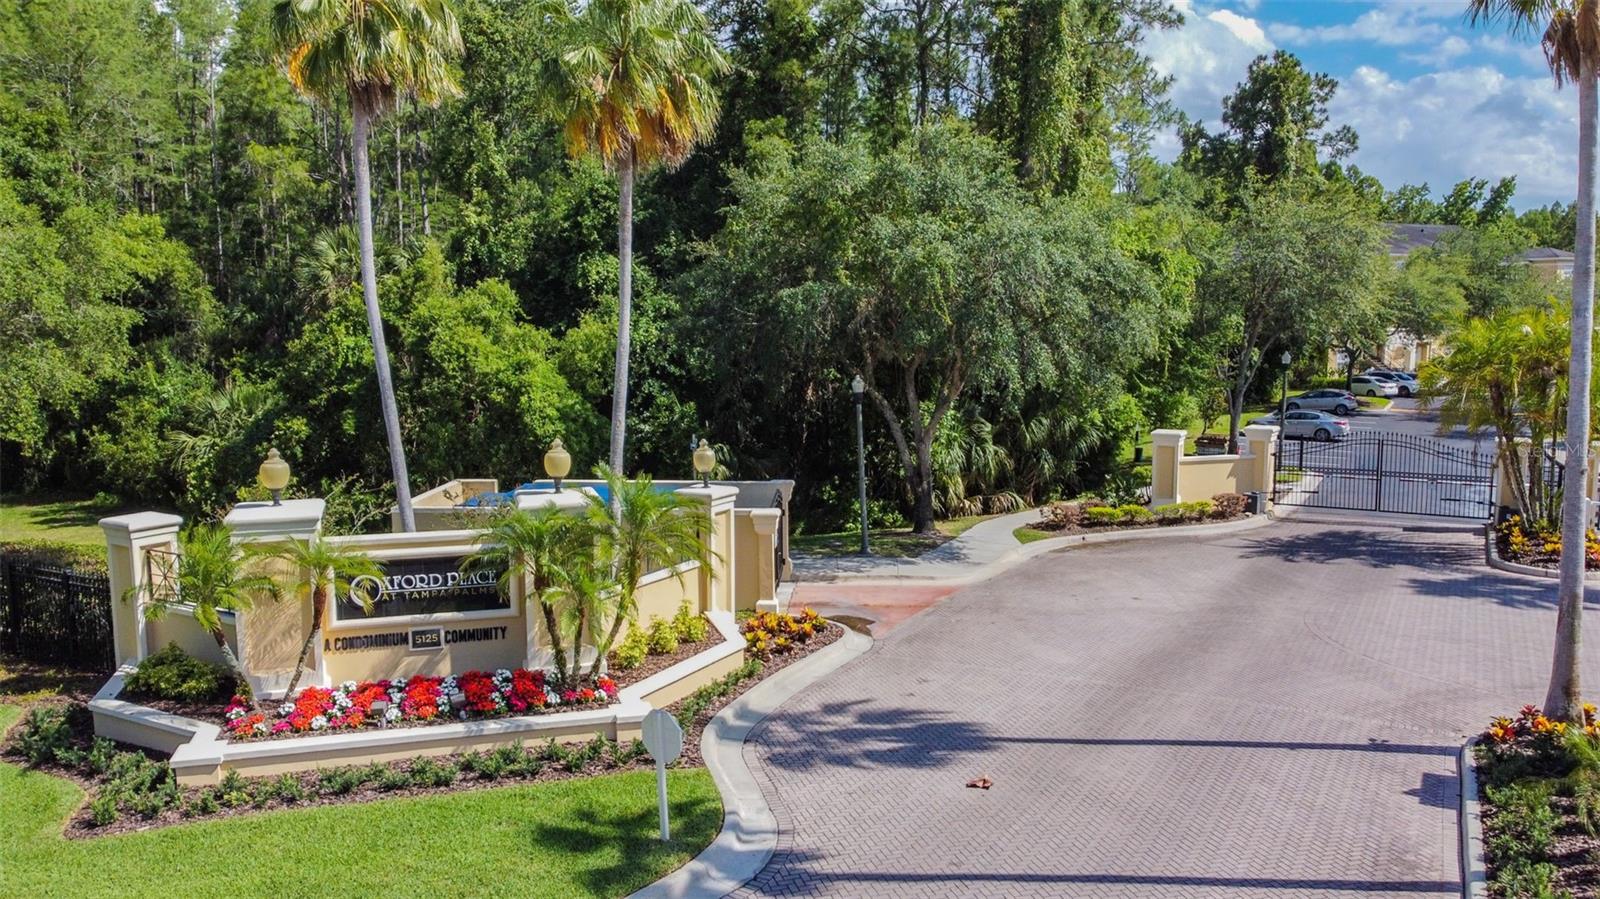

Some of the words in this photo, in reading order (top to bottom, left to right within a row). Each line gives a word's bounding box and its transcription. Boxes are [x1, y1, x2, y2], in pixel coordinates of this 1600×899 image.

[350, 573, 443, 607] OXFORD
[447, 570, 497, 589] PLACE
[382, 593, 397, 601] AT
[405, 588, 447, 600] TAMPA
[453, 586, 496, 596] PALMS
[324, 638, 331, 652] A
[335, 632, 409, 652] CONDOMINIUM
[415, 633, 438, 644] 5125
[444, 626, 508, 644] COMMUNITY
